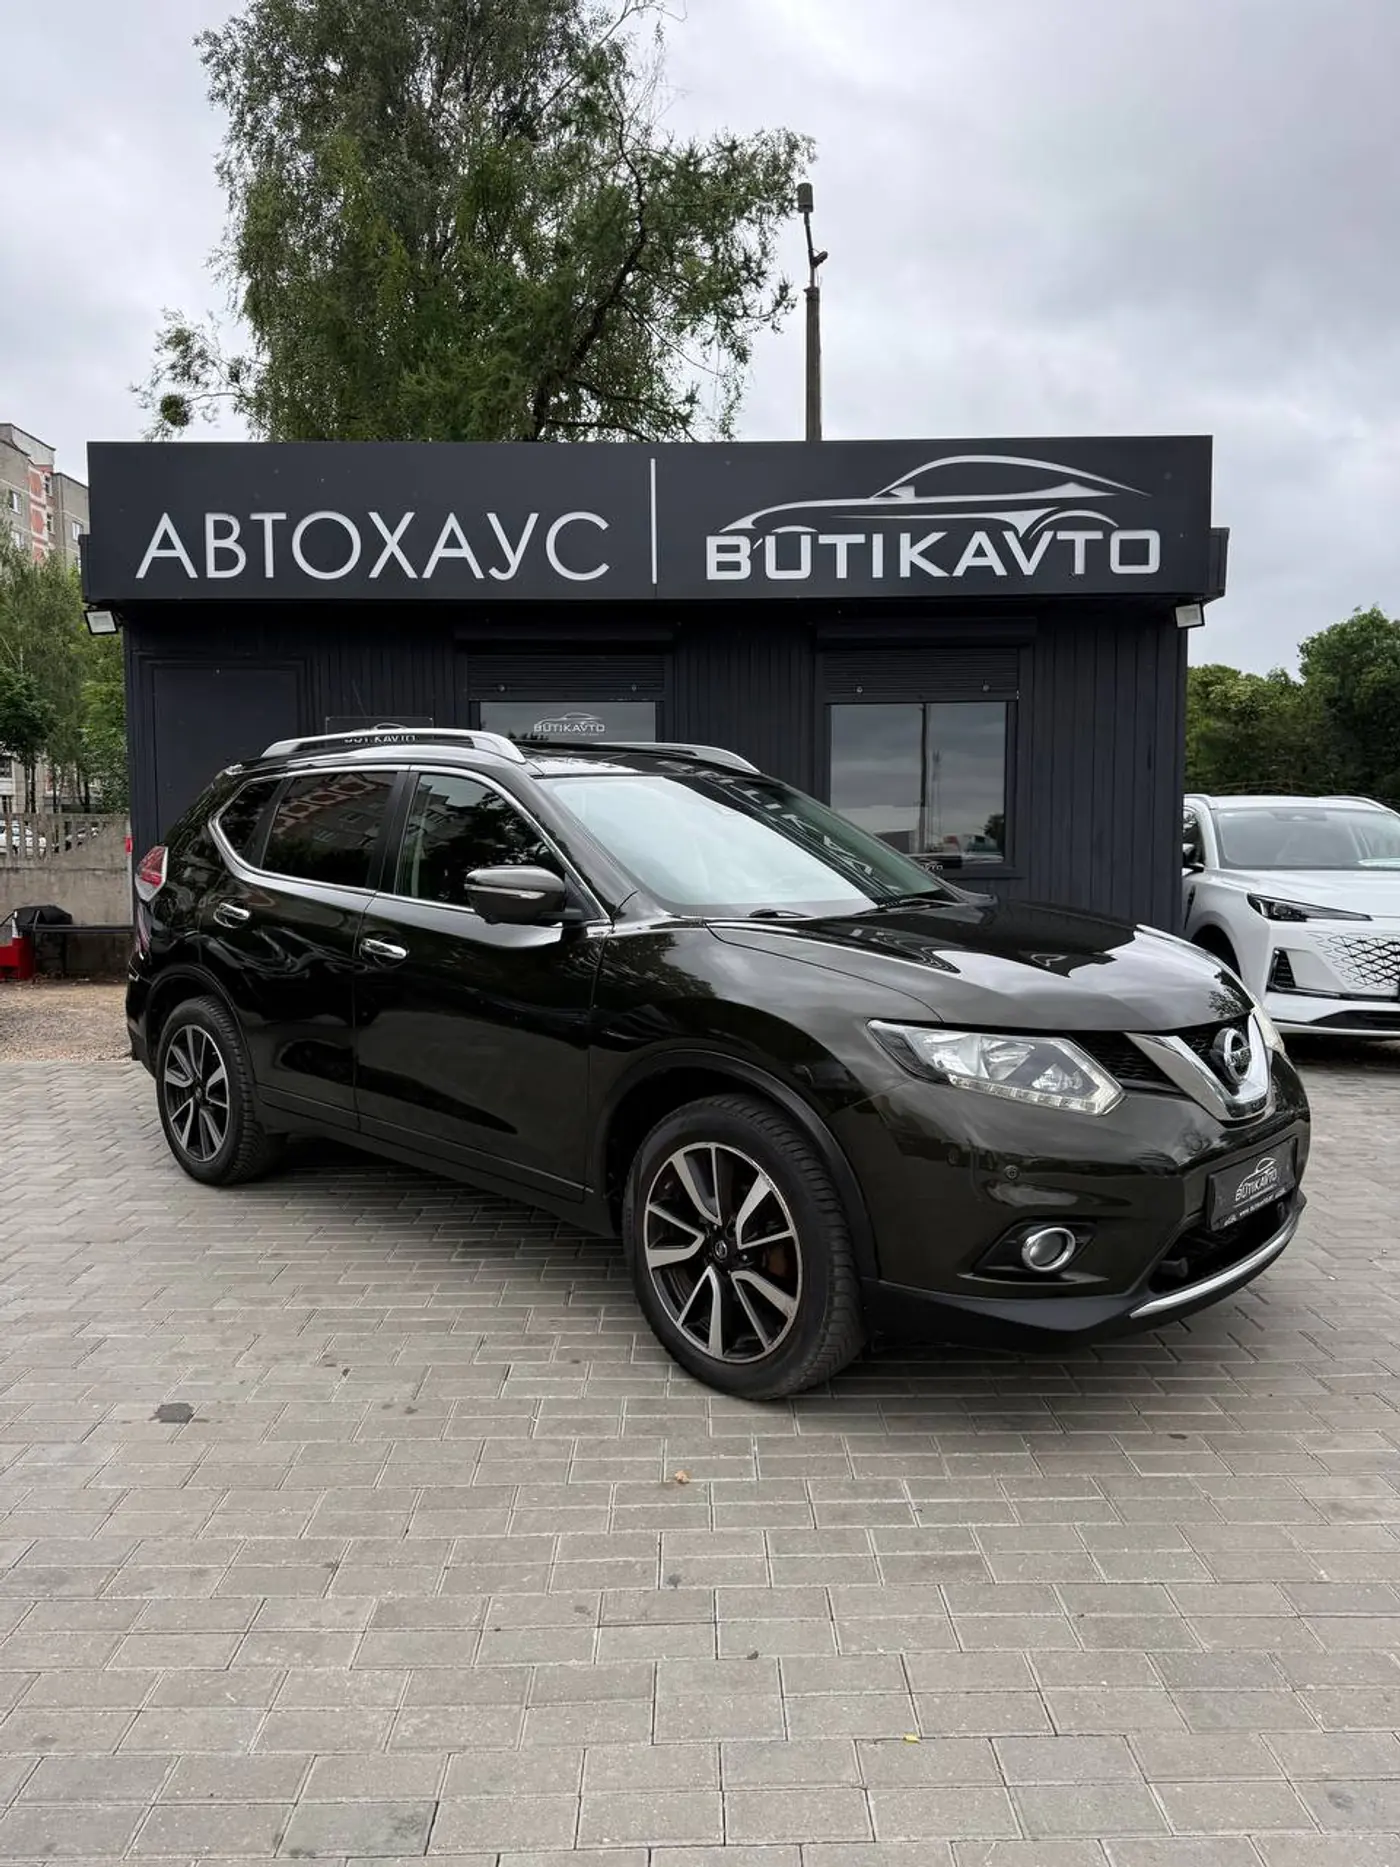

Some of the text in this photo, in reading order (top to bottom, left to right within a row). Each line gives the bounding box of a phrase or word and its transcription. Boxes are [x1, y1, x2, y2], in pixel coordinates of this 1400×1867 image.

[135, 511, 610, 581] АВТОХАУС
[705, 530, 1161, 581] BUTIKAVTO
[533, 723, 606, 733] BUTIKAVTO
